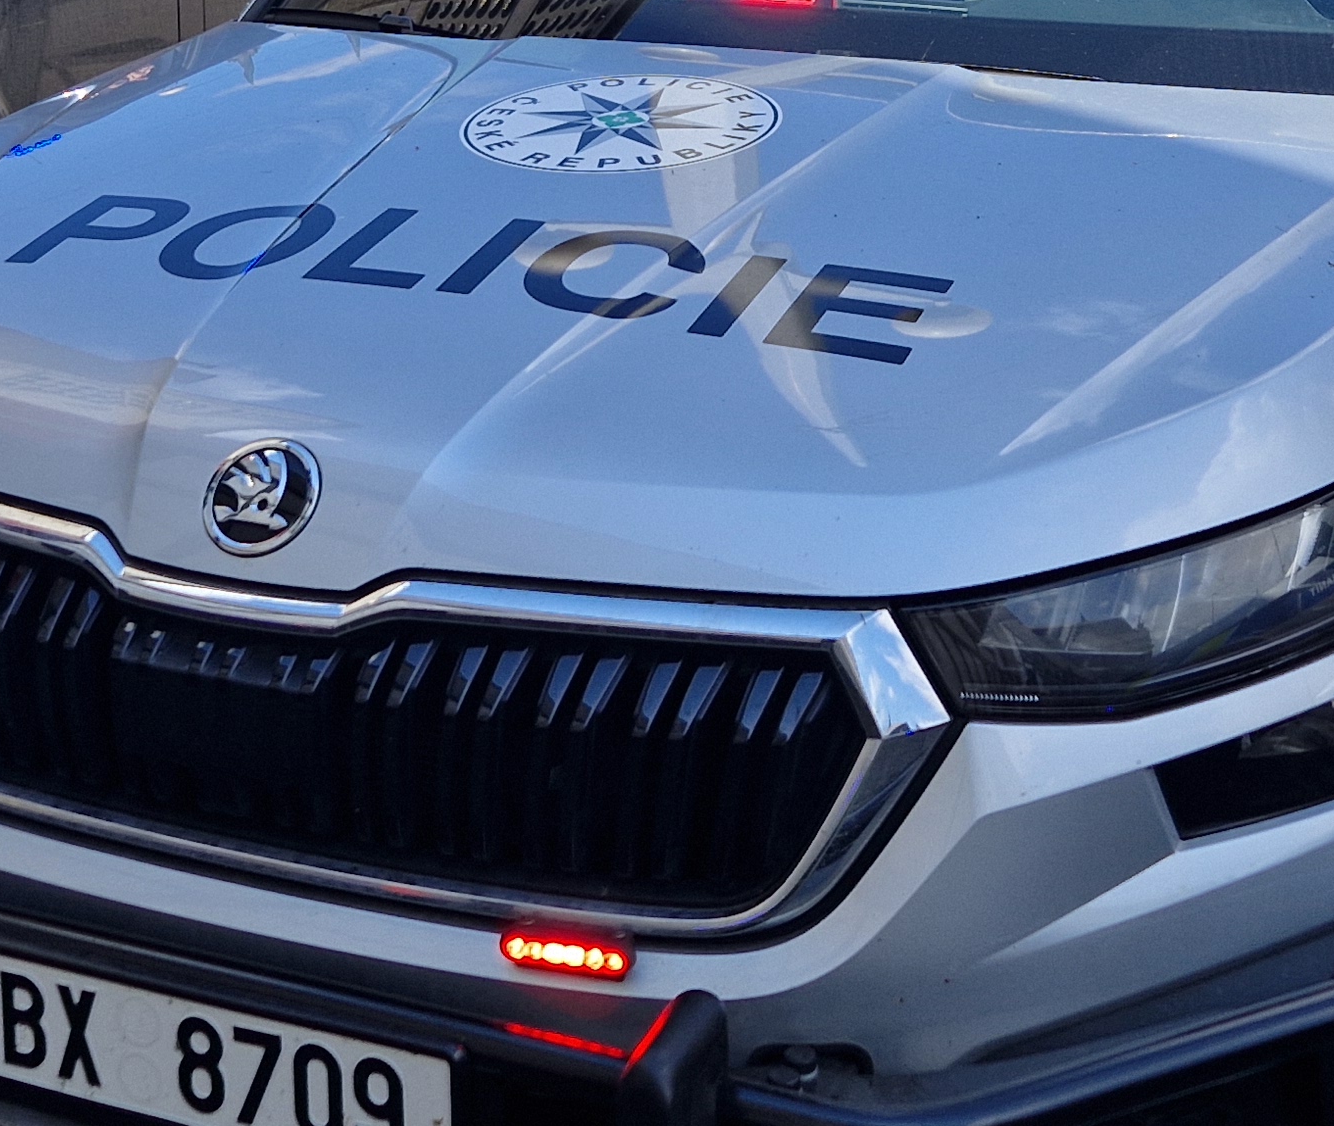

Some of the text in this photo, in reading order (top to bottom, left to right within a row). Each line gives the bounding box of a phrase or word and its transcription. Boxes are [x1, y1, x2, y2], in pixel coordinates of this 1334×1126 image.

[519, 110, 767, 169] REPUBLIKY
[7, 194, 954, 365] POLICIE
[176, 1016, 405, 1126] 8709
